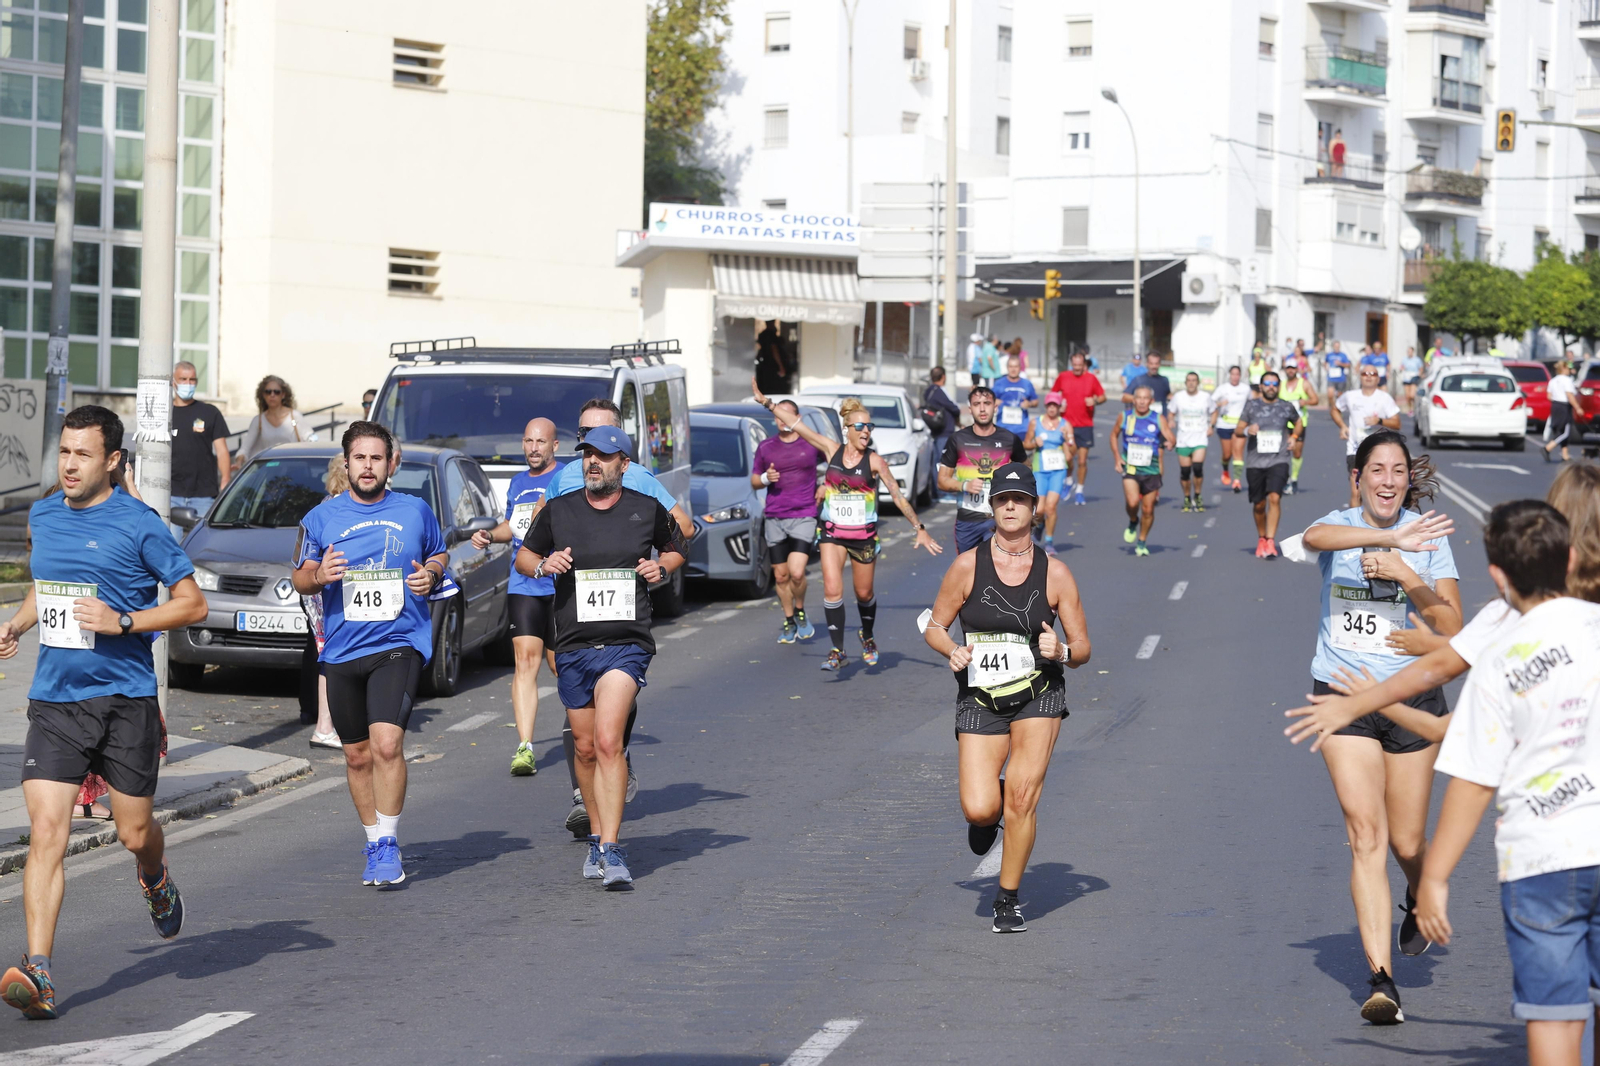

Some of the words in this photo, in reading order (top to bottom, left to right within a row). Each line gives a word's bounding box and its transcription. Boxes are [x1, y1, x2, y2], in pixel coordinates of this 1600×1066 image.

[676, 208, 764, 223] CHURROS
[701, 224, 785, 238] PATATAS
[791, 229, 856, 242] FRITAS
[836, 506, 853, 517] 100
[353, 573, 373, 581] VUELTA
[373, 572, 378, 580] A
[379, 571, 399, 580] HUELVA
[587, 571, 607, 580] VUELTA
[607, 571, 612, 579] A
[613, 571, 632, 579] HUELVA
[42, 584, 61, 595] VUELTA
[61, 585, 67, 595] A
[67, 586, 92, 597] HUELVA
[587, 589, 616, 607] 417
[1342, 589, 1366, 600] VUELTA
[353, 590, 382, 607] 418
[42, 607, 66, 630] 481
[249, 615, 284, 630] 9244
[1343, 611, 1377, 635] 345
[979, 634, 1001, 642] VUELTA
[1001, 633, 1006, 642] A
[1006, 634, 1026, 644] HUELVA
[979, 653, 1009, 672] 441
